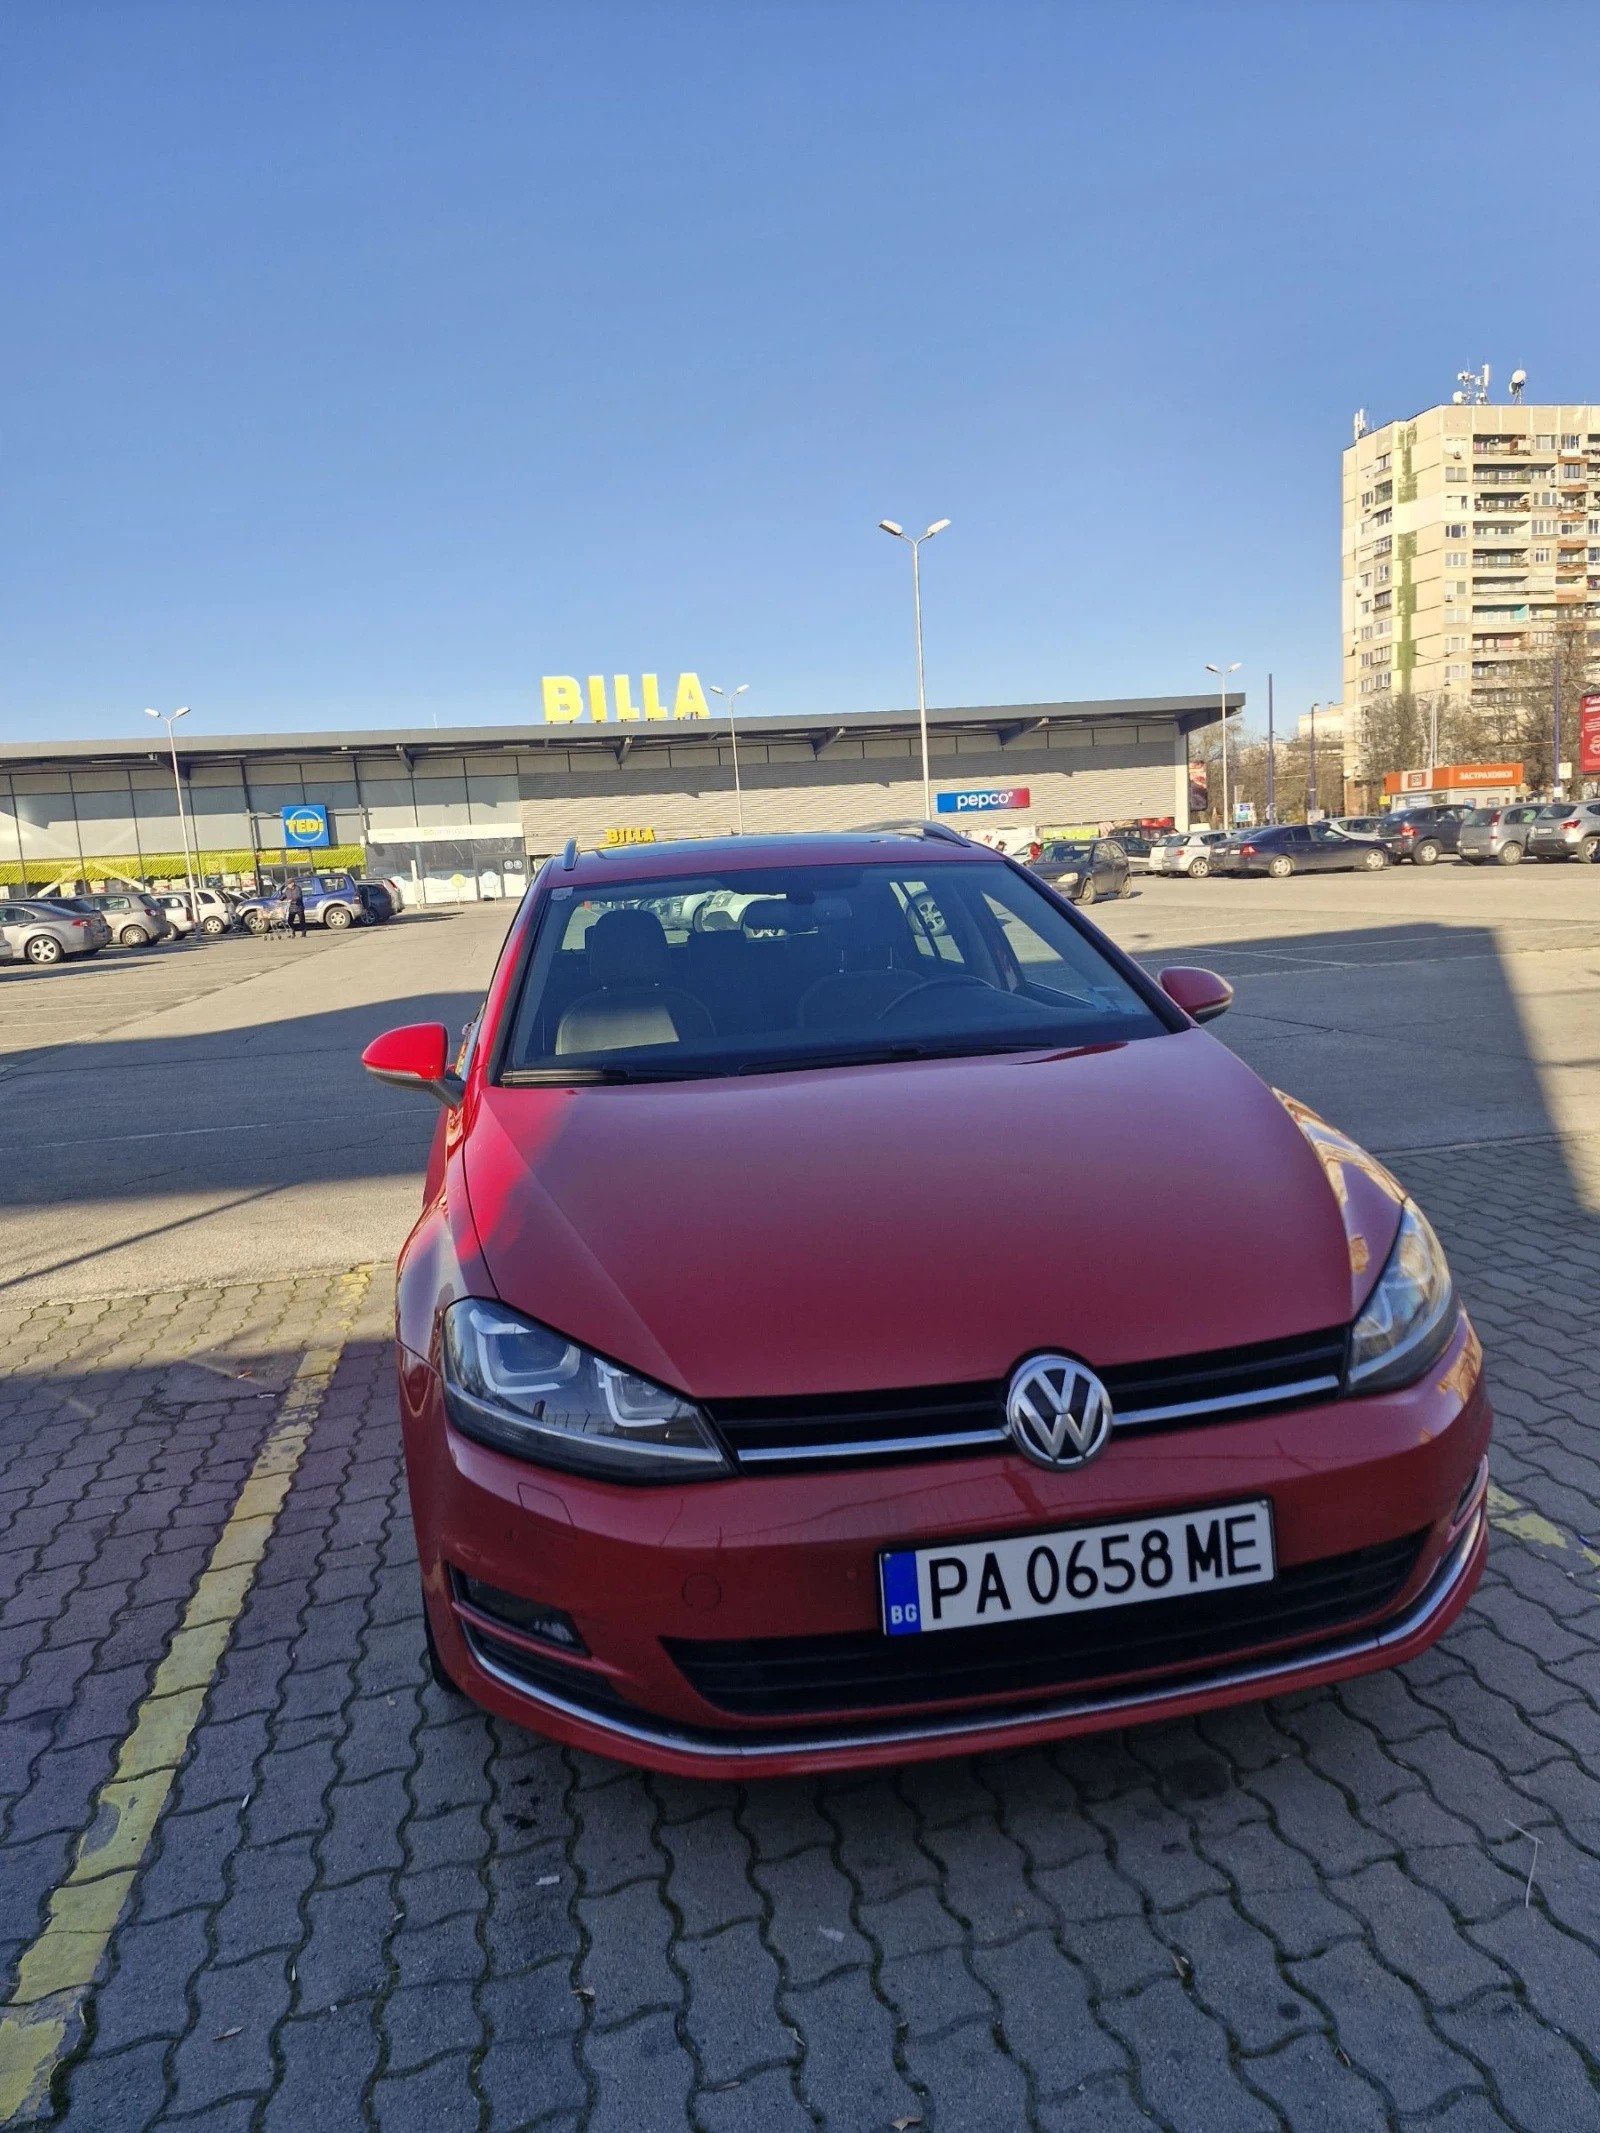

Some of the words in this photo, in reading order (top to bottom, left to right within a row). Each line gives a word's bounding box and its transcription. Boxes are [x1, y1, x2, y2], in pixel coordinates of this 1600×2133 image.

[542, 672, 711, 722] BILLA
[1459, 770, 1513, 780] ЗАСТРАХОВКИ
[957, 793, 1009, 810] pepco
[286, 818, 324, 833] TEDi
[606, 827, 655, 843] BILLA
[1011, 1358, 1105, 1462] VW
[928, 1552, 1011, 1620] PA
[1026, 1529, 1173, 1605] 0658
[1185, 1513, 1261, 1583] ME
[891, 1603, 918, 1625] BG
